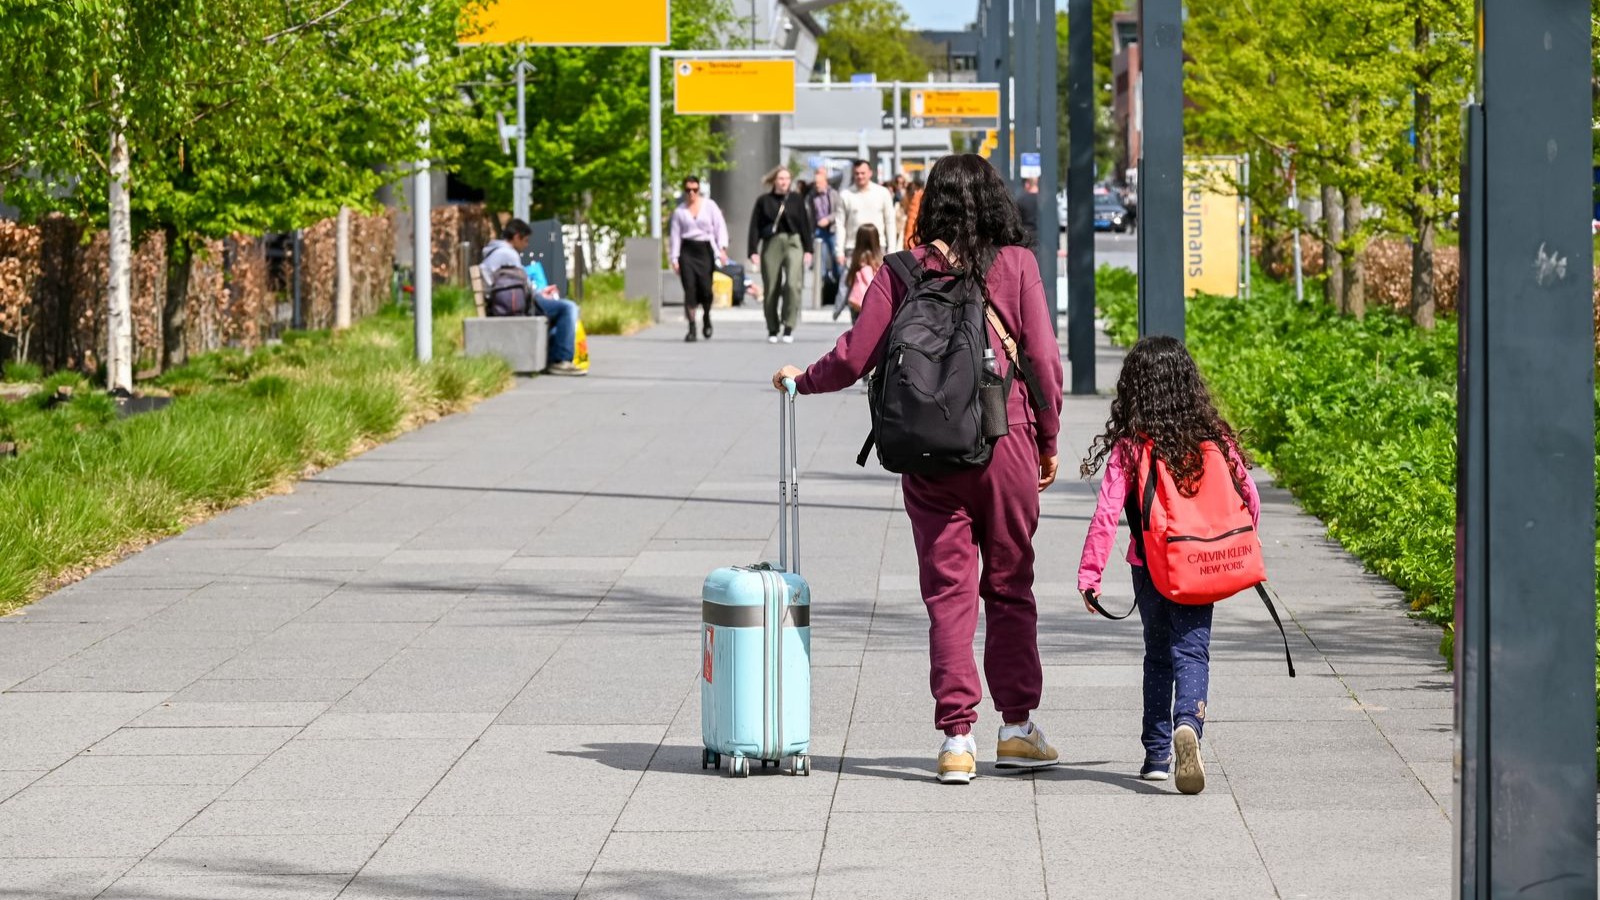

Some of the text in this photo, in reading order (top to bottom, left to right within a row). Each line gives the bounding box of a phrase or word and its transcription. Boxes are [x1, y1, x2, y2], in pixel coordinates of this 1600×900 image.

[1187, 544, 1252, 564] CALVIN KLEIN
[1200, 560, 1245, 576] NEW YORK
